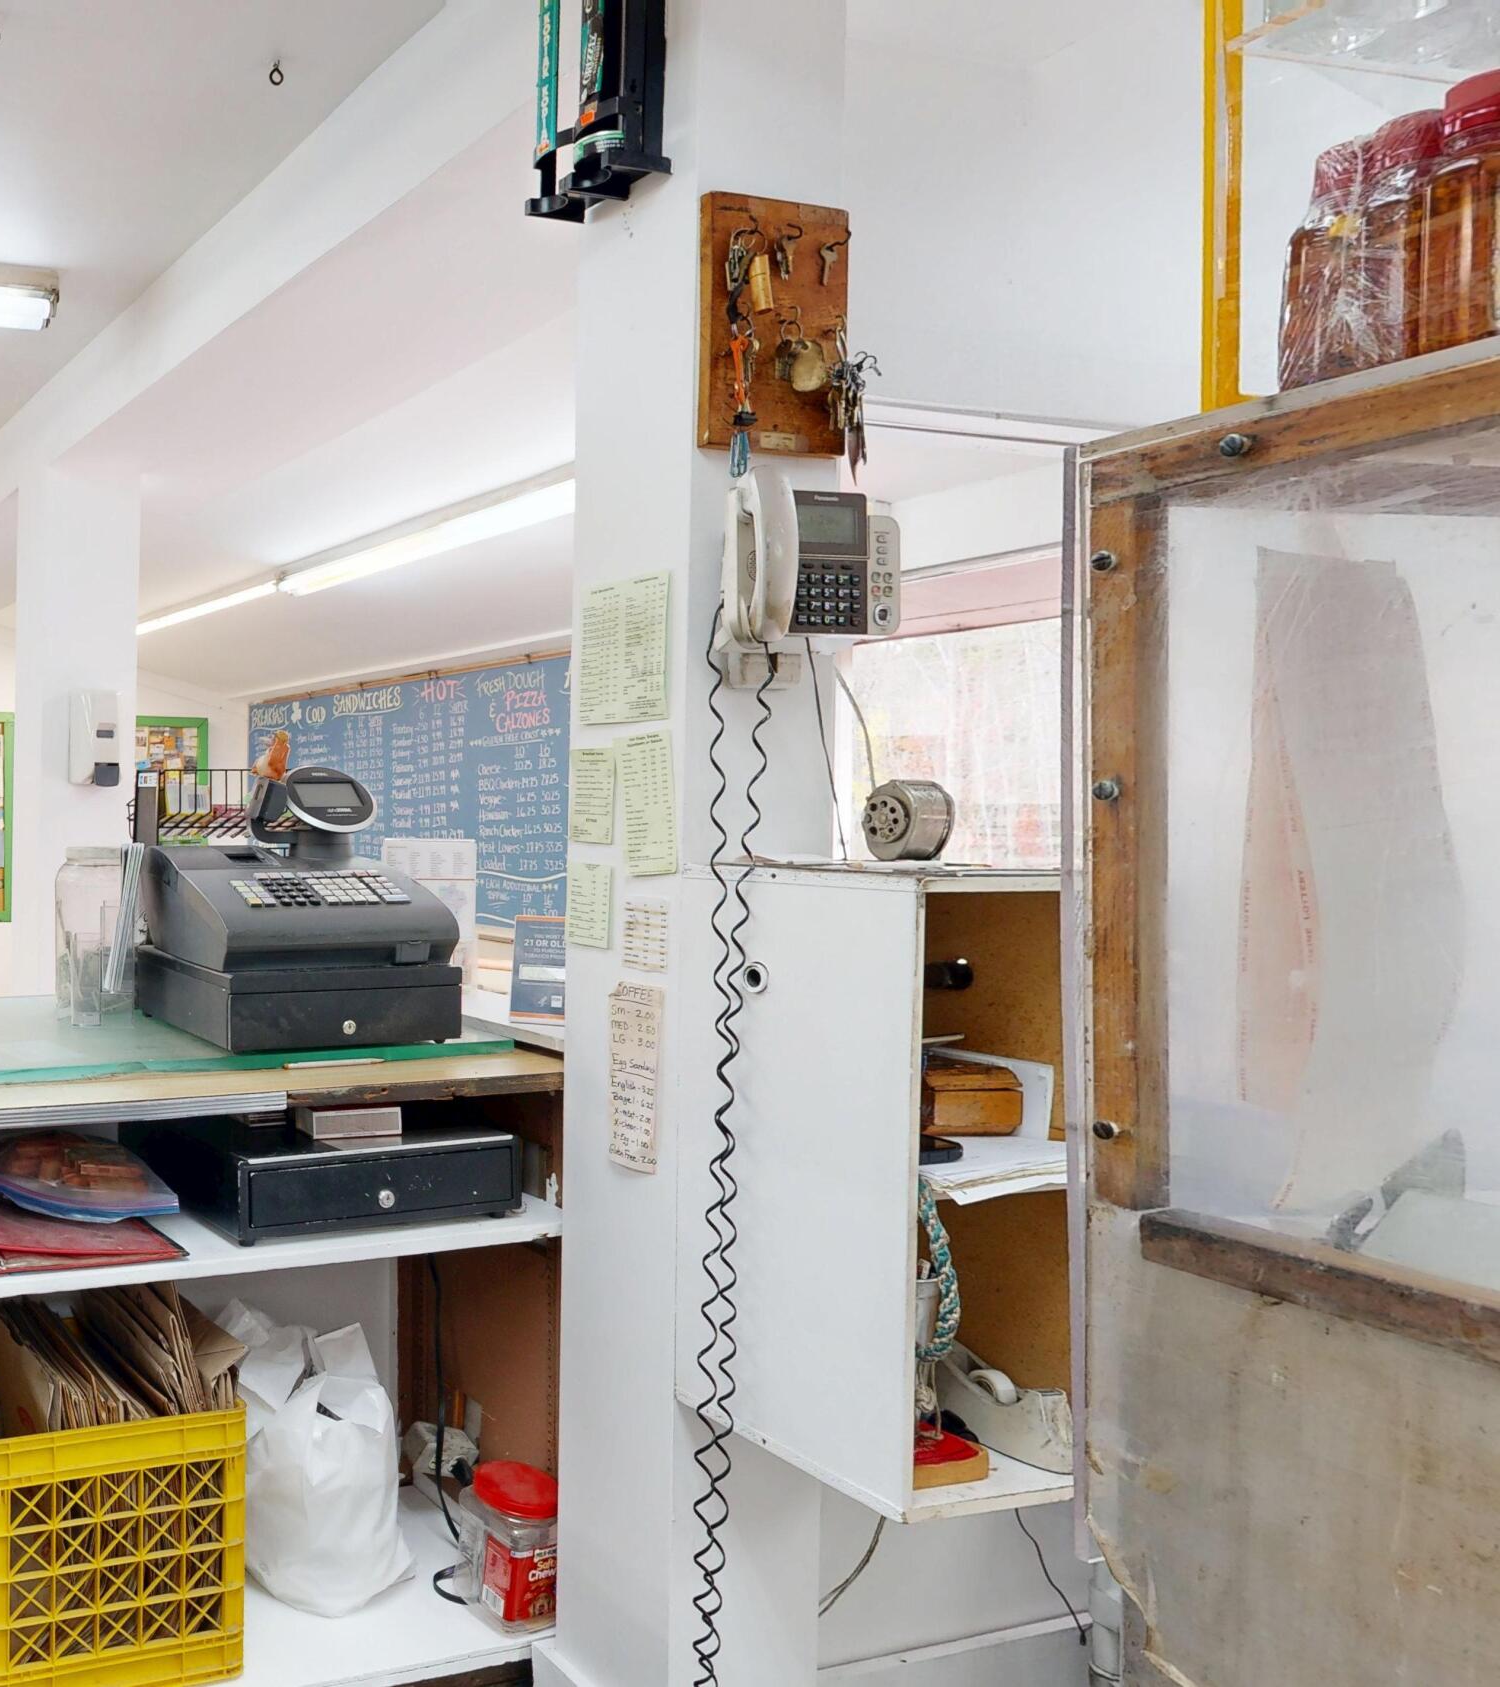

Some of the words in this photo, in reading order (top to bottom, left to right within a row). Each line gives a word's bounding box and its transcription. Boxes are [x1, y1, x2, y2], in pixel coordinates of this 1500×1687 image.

[506, 666, 546, 690] DOUGH
[332, 686, 401, 714] SANDWICHES
[421, 680, 459, 703] HOT
[503, 689, 547, 712] PIZZA
[495, 708, 551, 733] CALZONES
[524, 939, 534, 947] 21
[535, 940, 548, 948] OR
